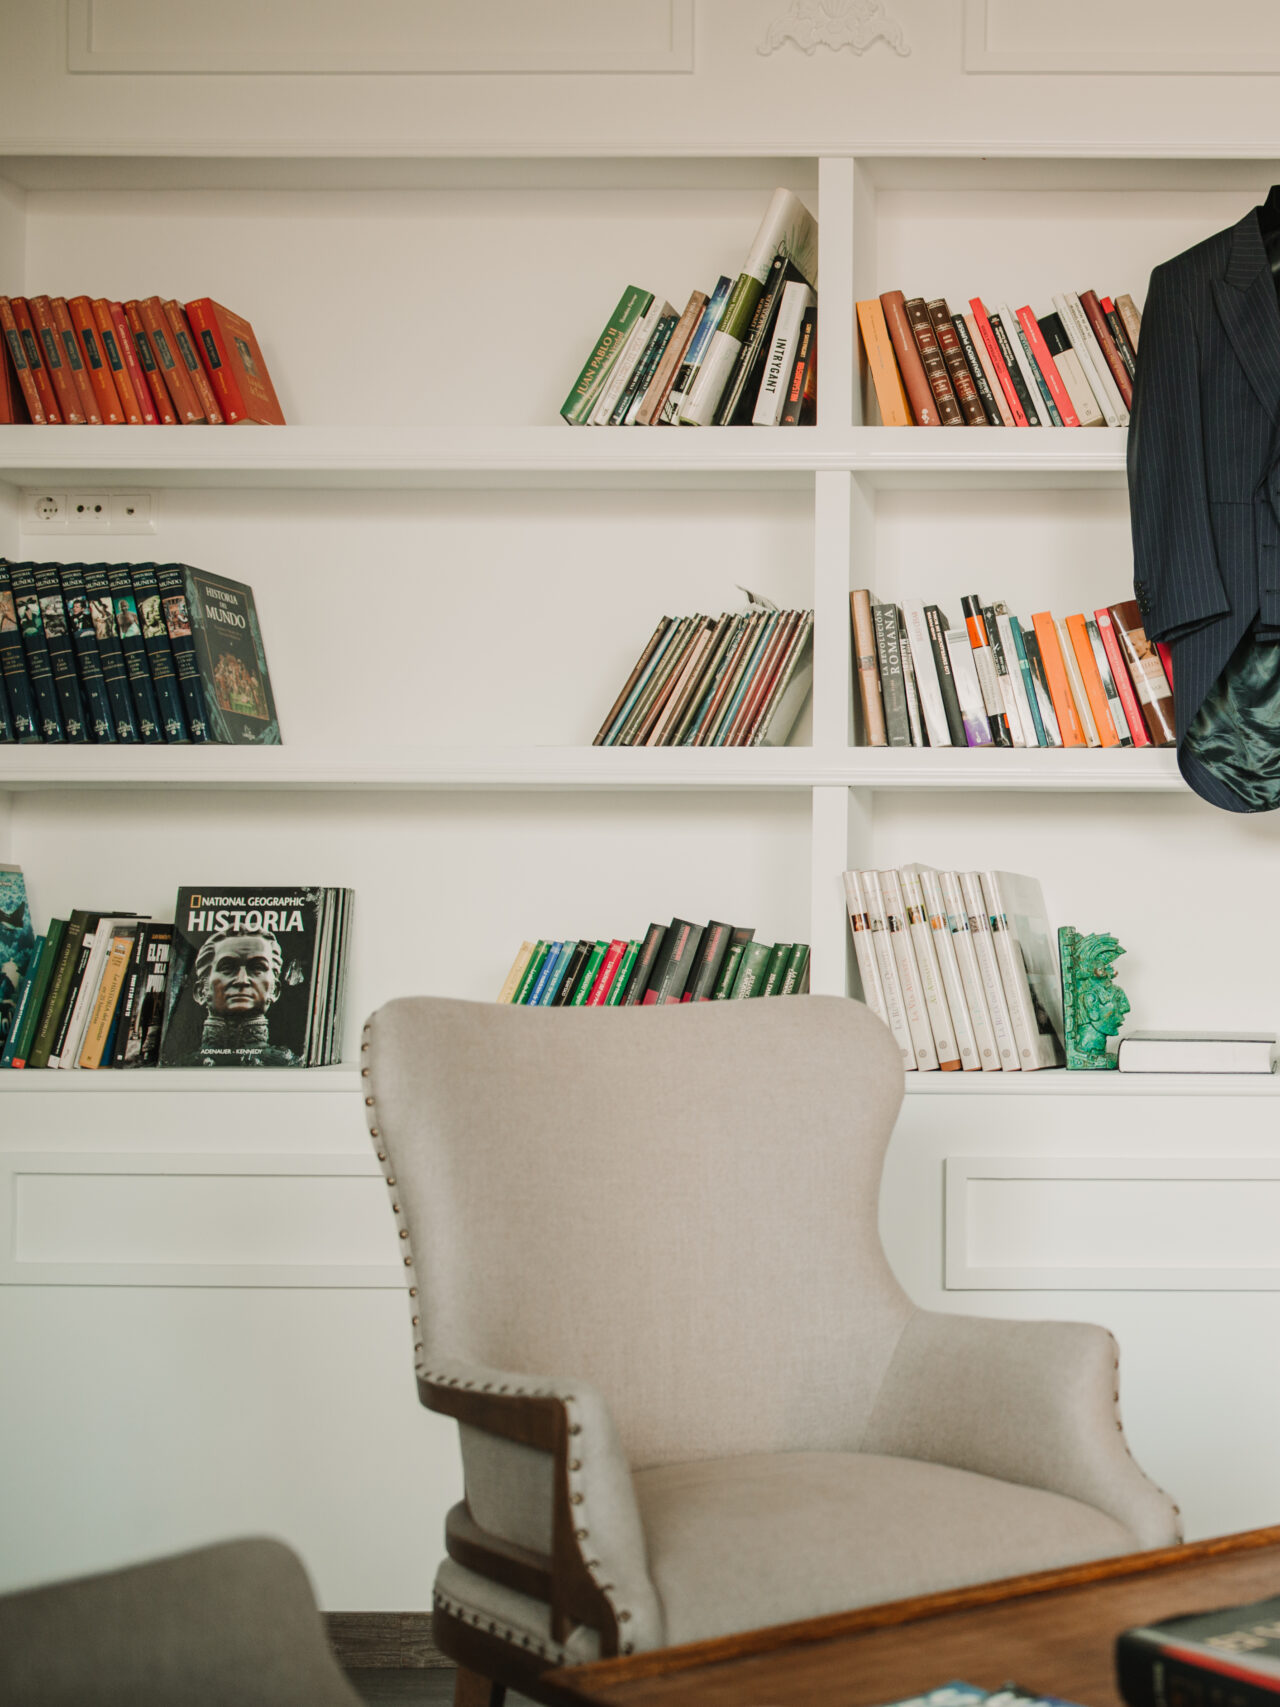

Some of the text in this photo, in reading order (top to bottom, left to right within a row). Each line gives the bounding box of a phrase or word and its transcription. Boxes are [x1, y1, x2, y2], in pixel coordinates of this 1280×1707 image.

[955, 318, 982, 377] EDUARDO PUNSET
[575, 326, 616, 395] JUAN PABLO II
[764, 337, 787, 394] INTRYGANT
[12, 578, 35, 586] MUNDO
[62, 579, 84, 588] MUNDO
[86, 580, 109, 589] MUNDO
[109, 578, 131, 588] MUNDO
[133, 579, 157, 587] MUNDO
[159, 579, 183, 588] MUNDO
[206, 586, 238, 605] HISTORIA
[206, 604, 246, 628] MUNDO
[874, 610, 888, 675] LA REVOLUCIÓN
[883, 608, 900, 674] ROMANA
[201, 896, 305, 907] NATIONAL GEOGRAPHIC
[187, 910, 304, 932] HISTORIA
[103, 981, 117, 1011] HISTORIA
